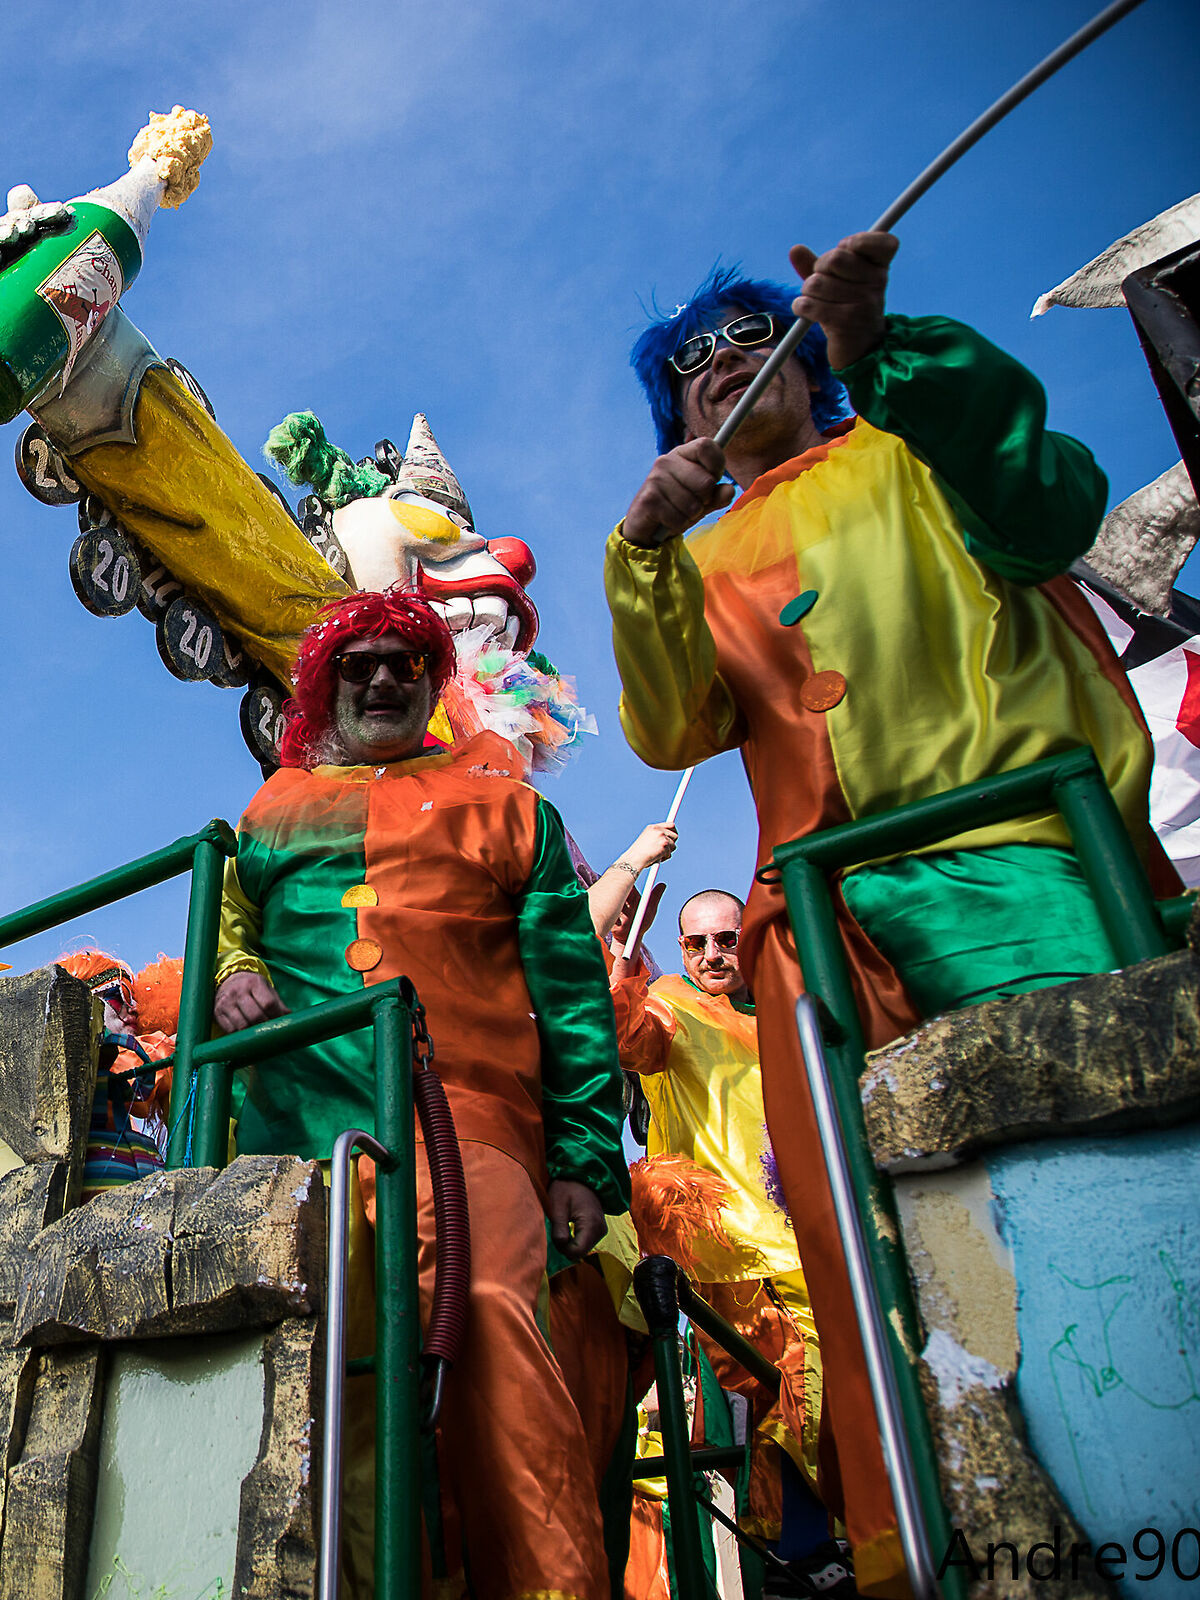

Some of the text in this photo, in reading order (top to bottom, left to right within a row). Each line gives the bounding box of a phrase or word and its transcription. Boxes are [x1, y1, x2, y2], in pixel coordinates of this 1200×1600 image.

[92, 539, 129, 602] 20
[179, 609, 213, 669] 20
[259, 696, 287, 753] 20
